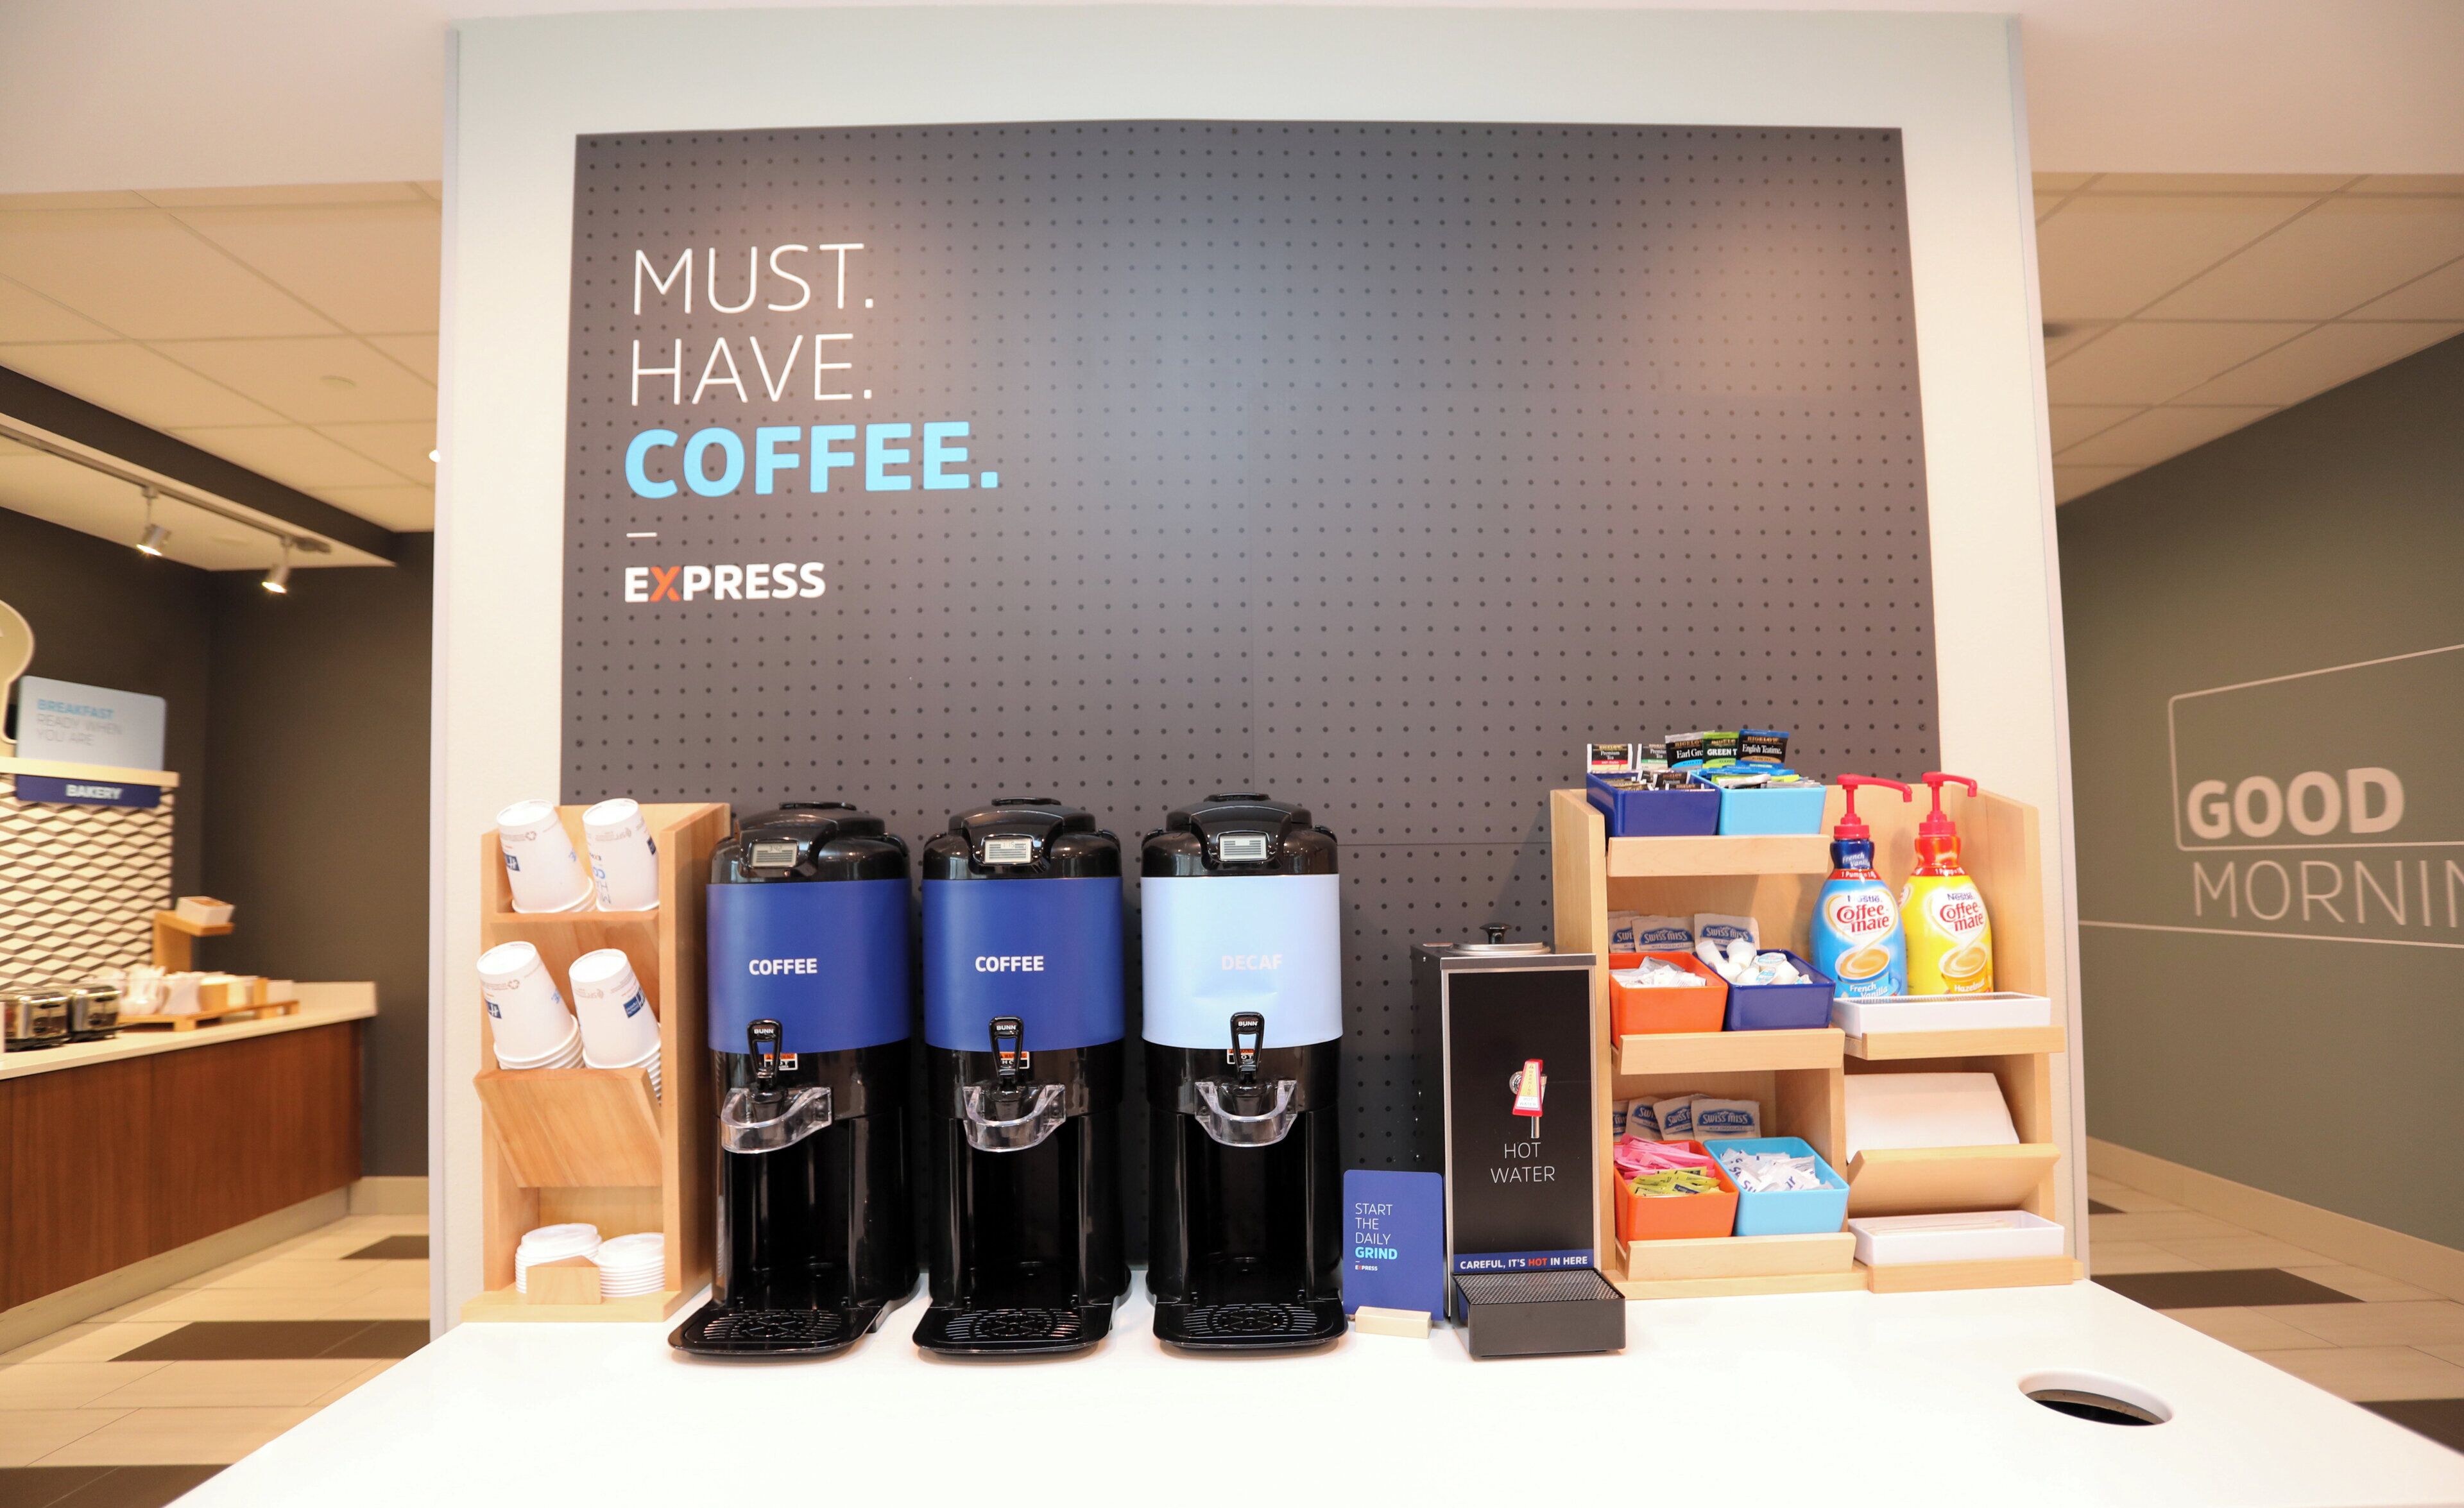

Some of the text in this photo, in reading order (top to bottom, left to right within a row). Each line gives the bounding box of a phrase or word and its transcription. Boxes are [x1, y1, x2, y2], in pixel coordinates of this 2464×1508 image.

[633, 243, 873, 315] MUST.
[631, 333, 872, 406] HAVE.
[625, 422, 998, 499] COFFEE.
[624, 562, 826, 603] EXPRESS
[37, 699, 114, 719] BREAKFAST
[1677, 748, 1703, 758] Earl Gre
[1741, 744, 1761, 754] English
[65, 784, 123, 800] BAKERY
[2187, 767, 2405, 839] GOOD
[1851, 916, 1889, 932] mate
[1954, 913, 1983, 932] mate
[1644, 932, 1666, 943] SWISS
[749, 957, 817, 975] COFFEE
[975, 955, 1044, 972] COFFEE
[1222, 954, 1283, 970] DECAF
[1850, 983, 1877, 993] French
[1702, 1114, 1726, 1124] SWISS
[1505, 1142, 1541, 1159] HOT
[1491, 1166, 1555, 1183] WATER
[1355, 1203, 1392, 1215] START
[1355, 1217, 1379, 1230] THE
[1355, 1232, 1391, 1245] DAILY
[1355, 1246, 1398, 1260] GRIND
[1460, 1256, 1587, 1269] CAREFUL, IT'S HOT IN HERE
